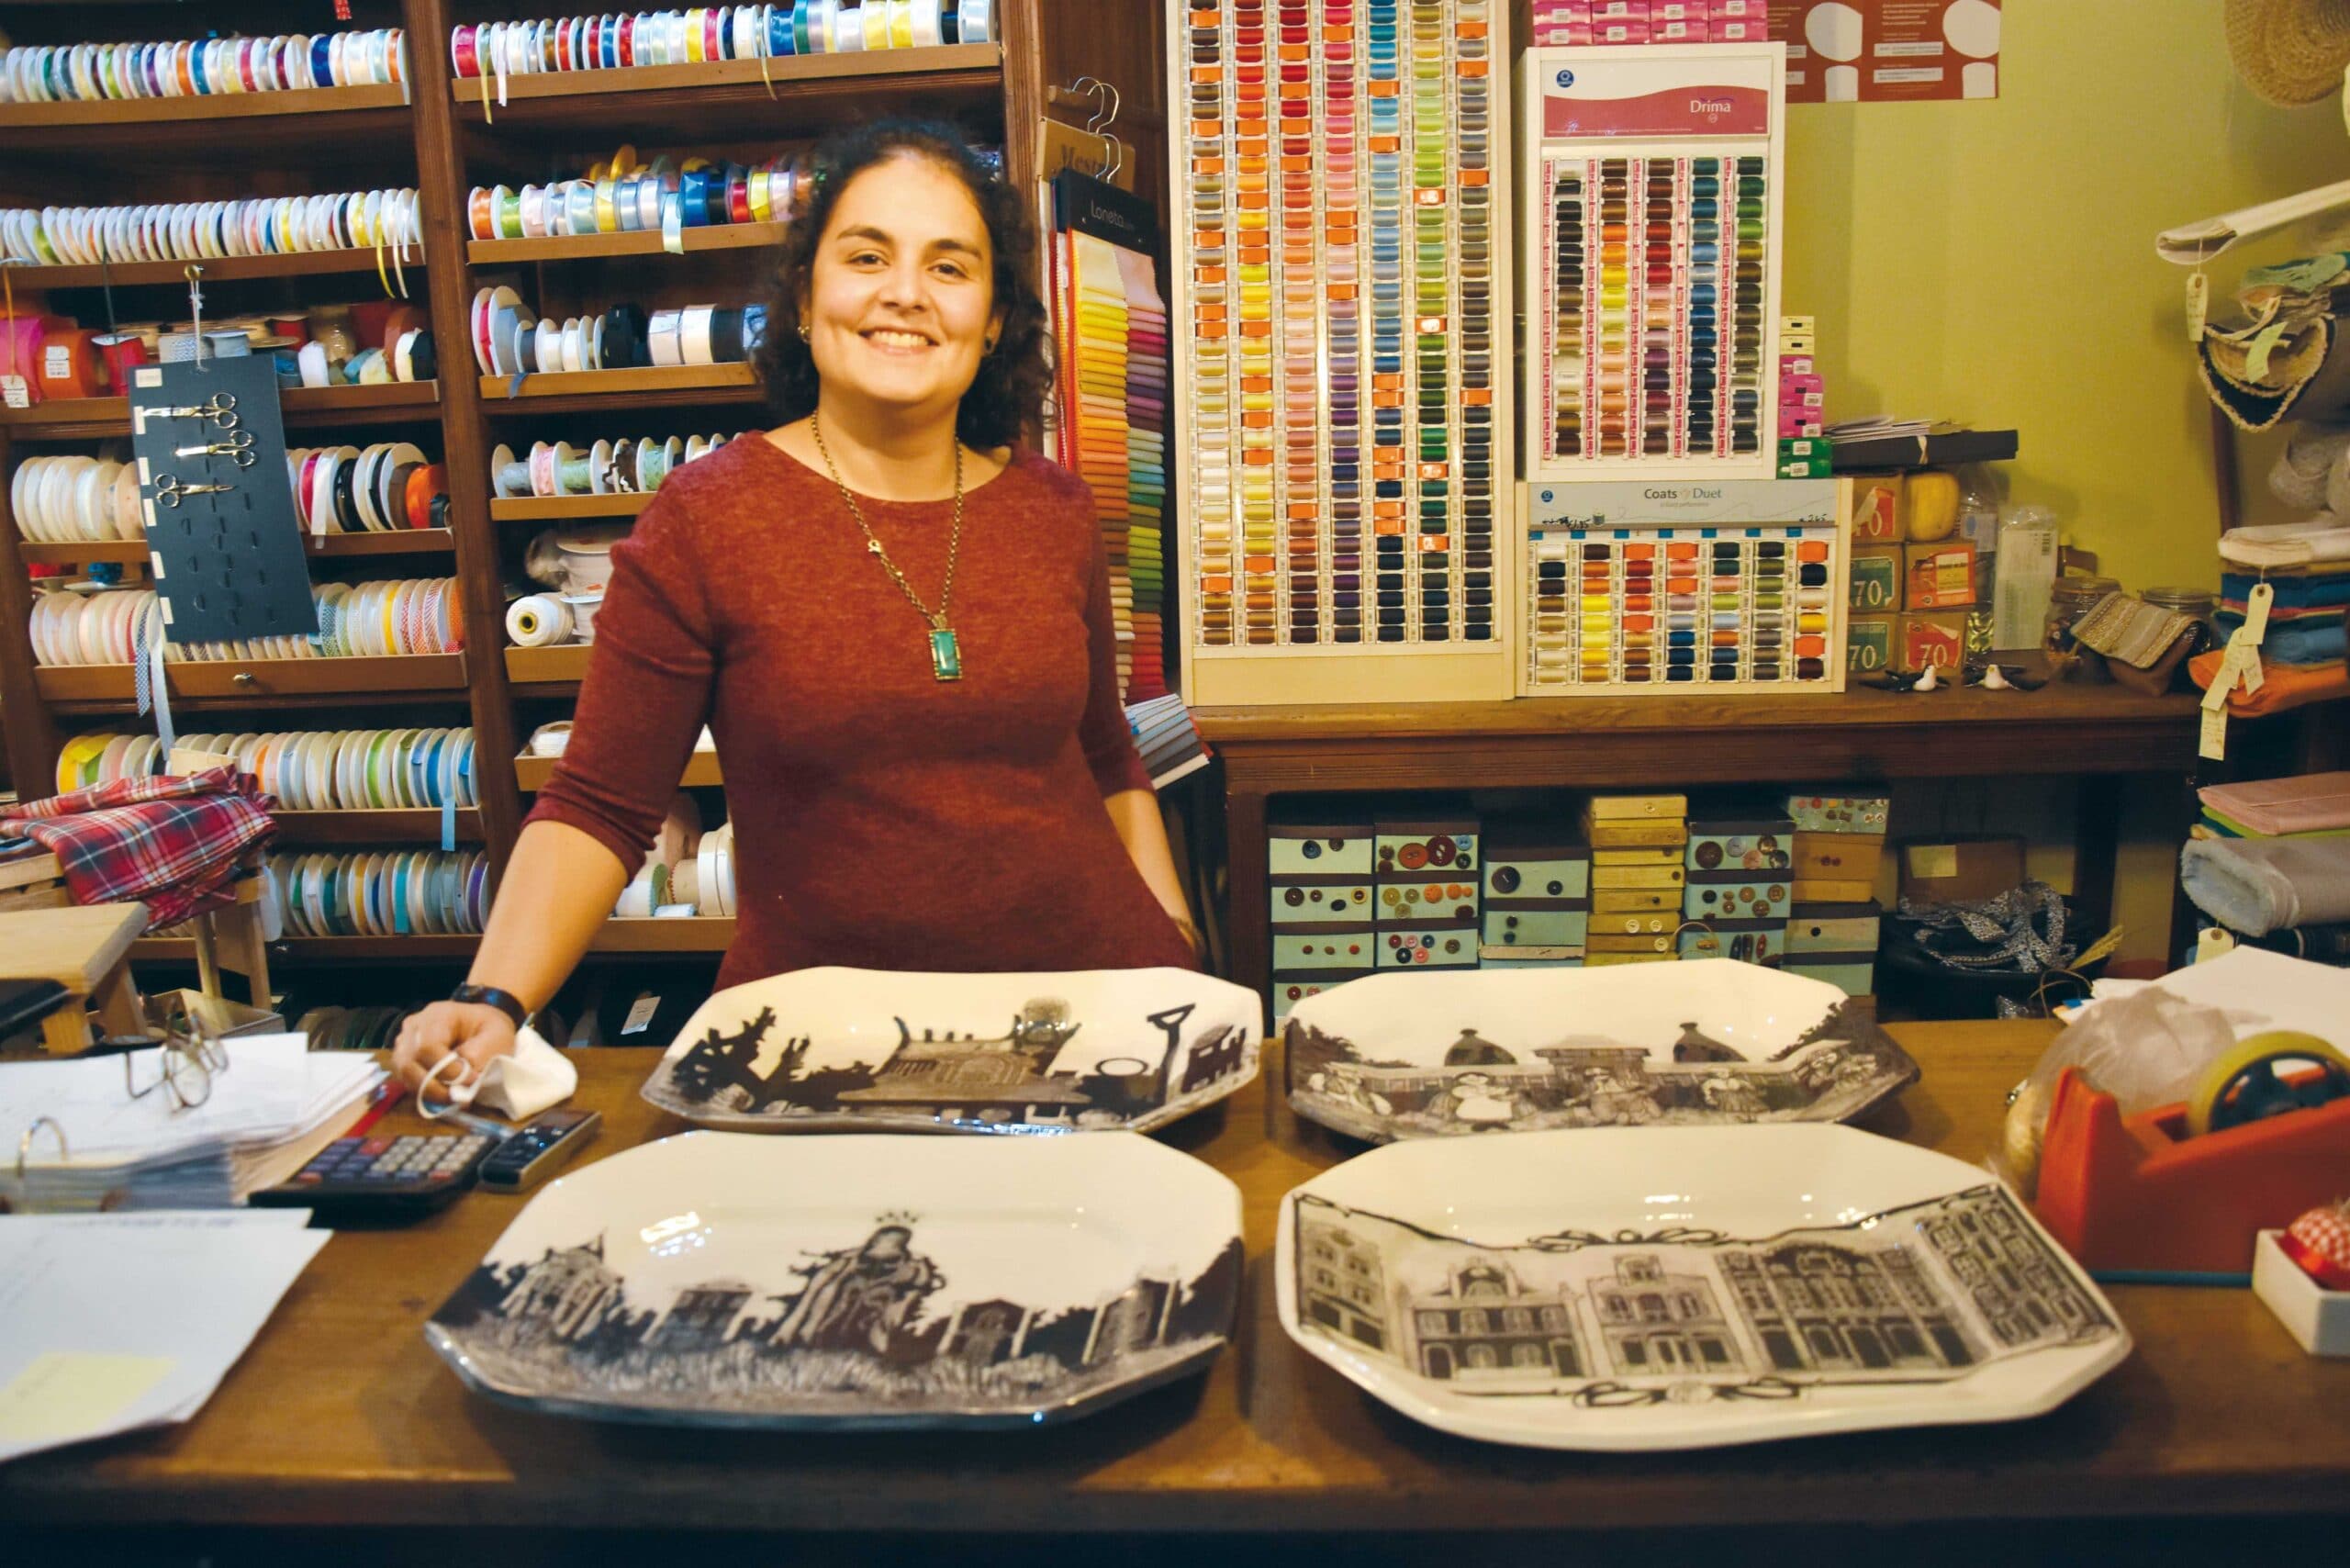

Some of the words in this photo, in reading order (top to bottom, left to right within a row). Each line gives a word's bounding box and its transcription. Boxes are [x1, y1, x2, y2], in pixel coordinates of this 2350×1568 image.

[1690, 100, 1731, 113] Drima
[1091, 198, 1125, 228] Loneta
[1644, 488, 1678, 499] Coats
[1693, 487, 1721, 498] Duet
[1853, 580, 1882, 607] 70
[1849, 644, 1876, 670] 70
[1919, 644, 1947, 669] 70
